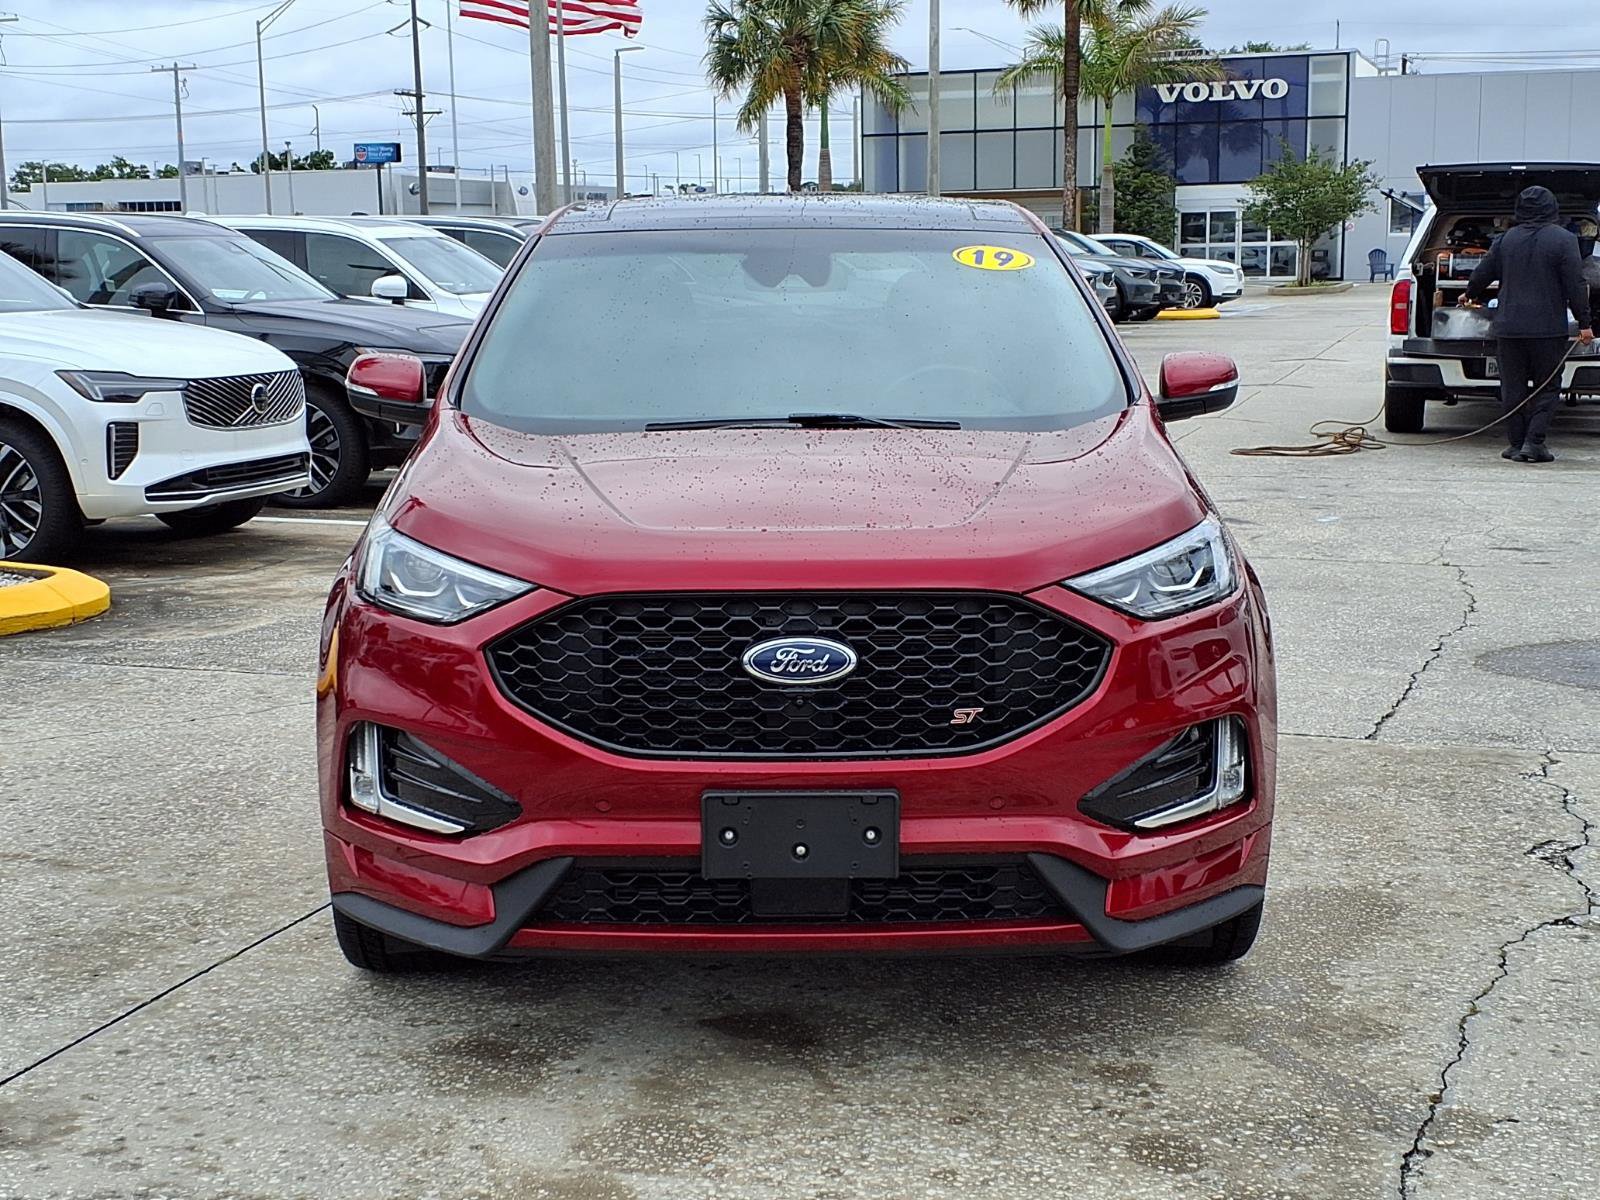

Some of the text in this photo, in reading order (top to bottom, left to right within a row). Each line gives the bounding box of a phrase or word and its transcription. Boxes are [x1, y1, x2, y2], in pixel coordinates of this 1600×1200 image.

[1152, 78, 1289, 103] VOLVO
[972, 250, 1014, 267] 19
[770, 647, 830, 673] Ford
[950, 707, 984, 724] ST
